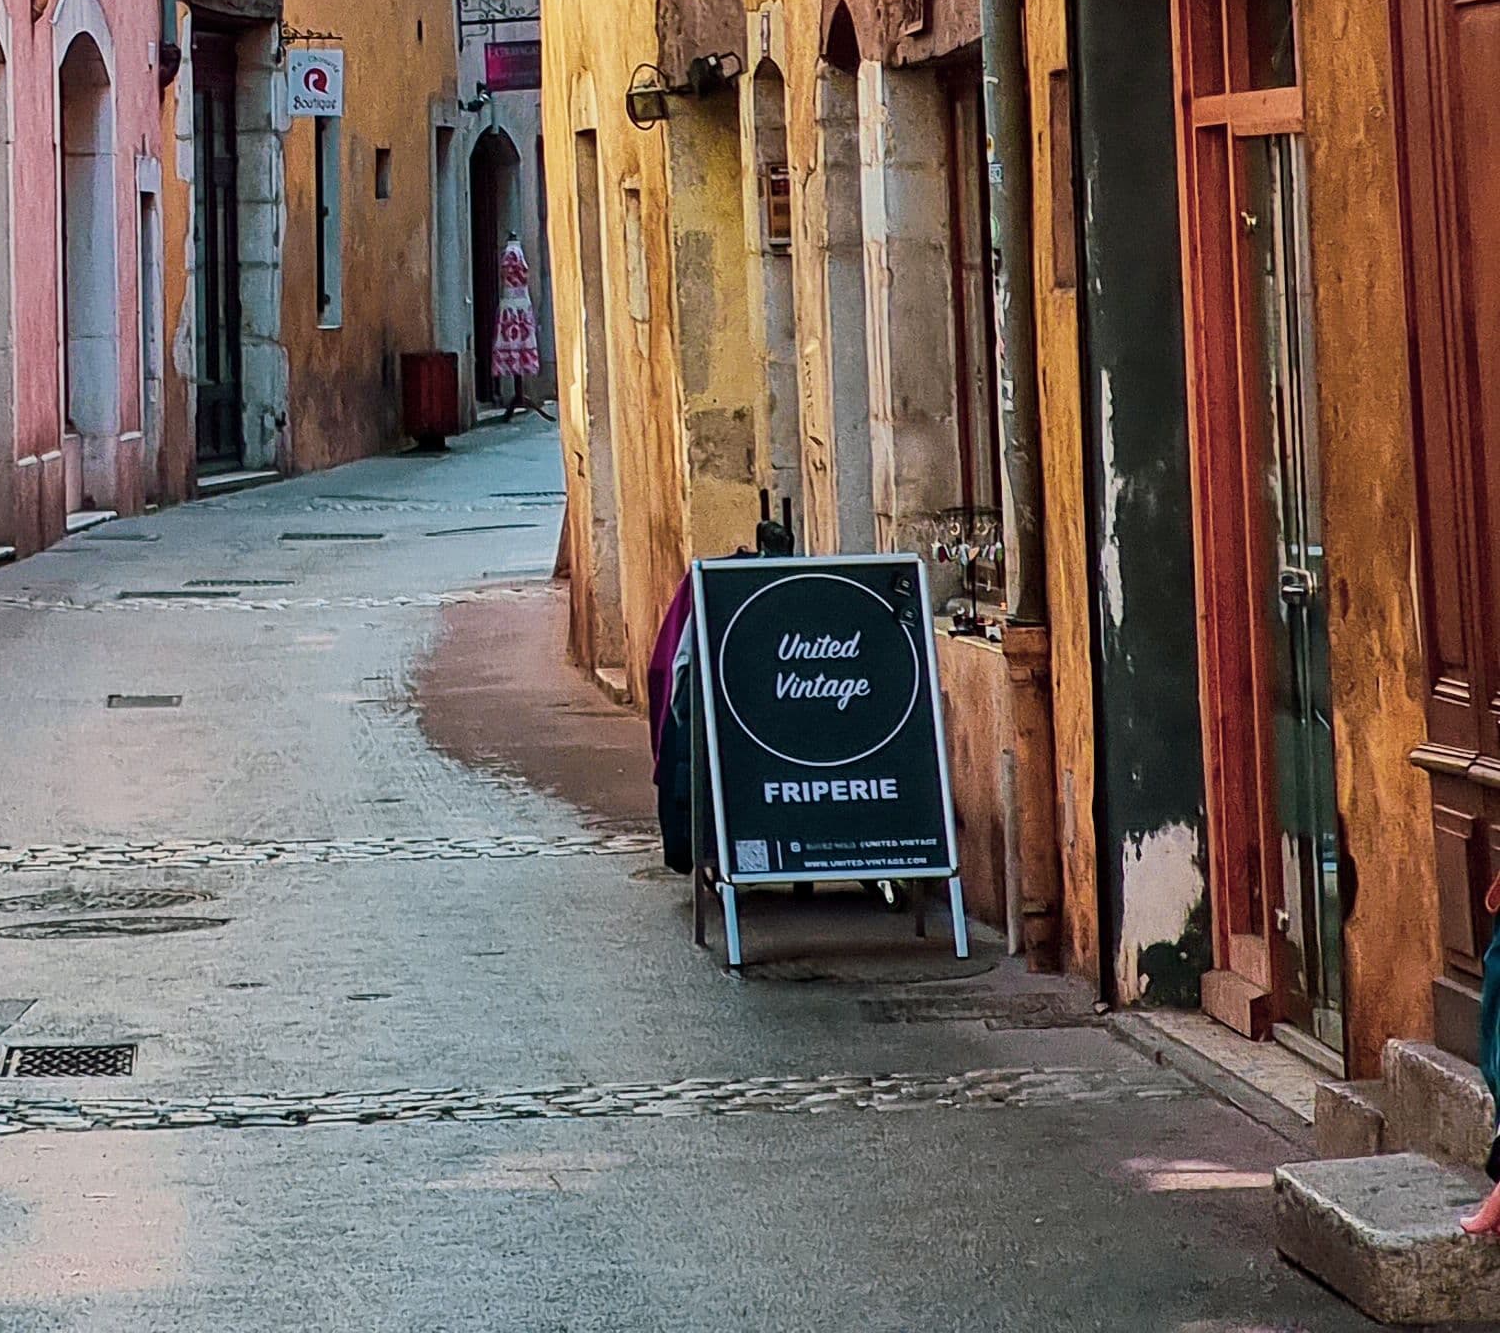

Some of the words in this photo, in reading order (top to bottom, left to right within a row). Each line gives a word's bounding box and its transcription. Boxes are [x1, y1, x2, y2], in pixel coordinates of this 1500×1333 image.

[778, 630, 862, 661] United
[775, 671, 871, 711] Vintage
[763, 778, 899, 804] FRIPERIE
